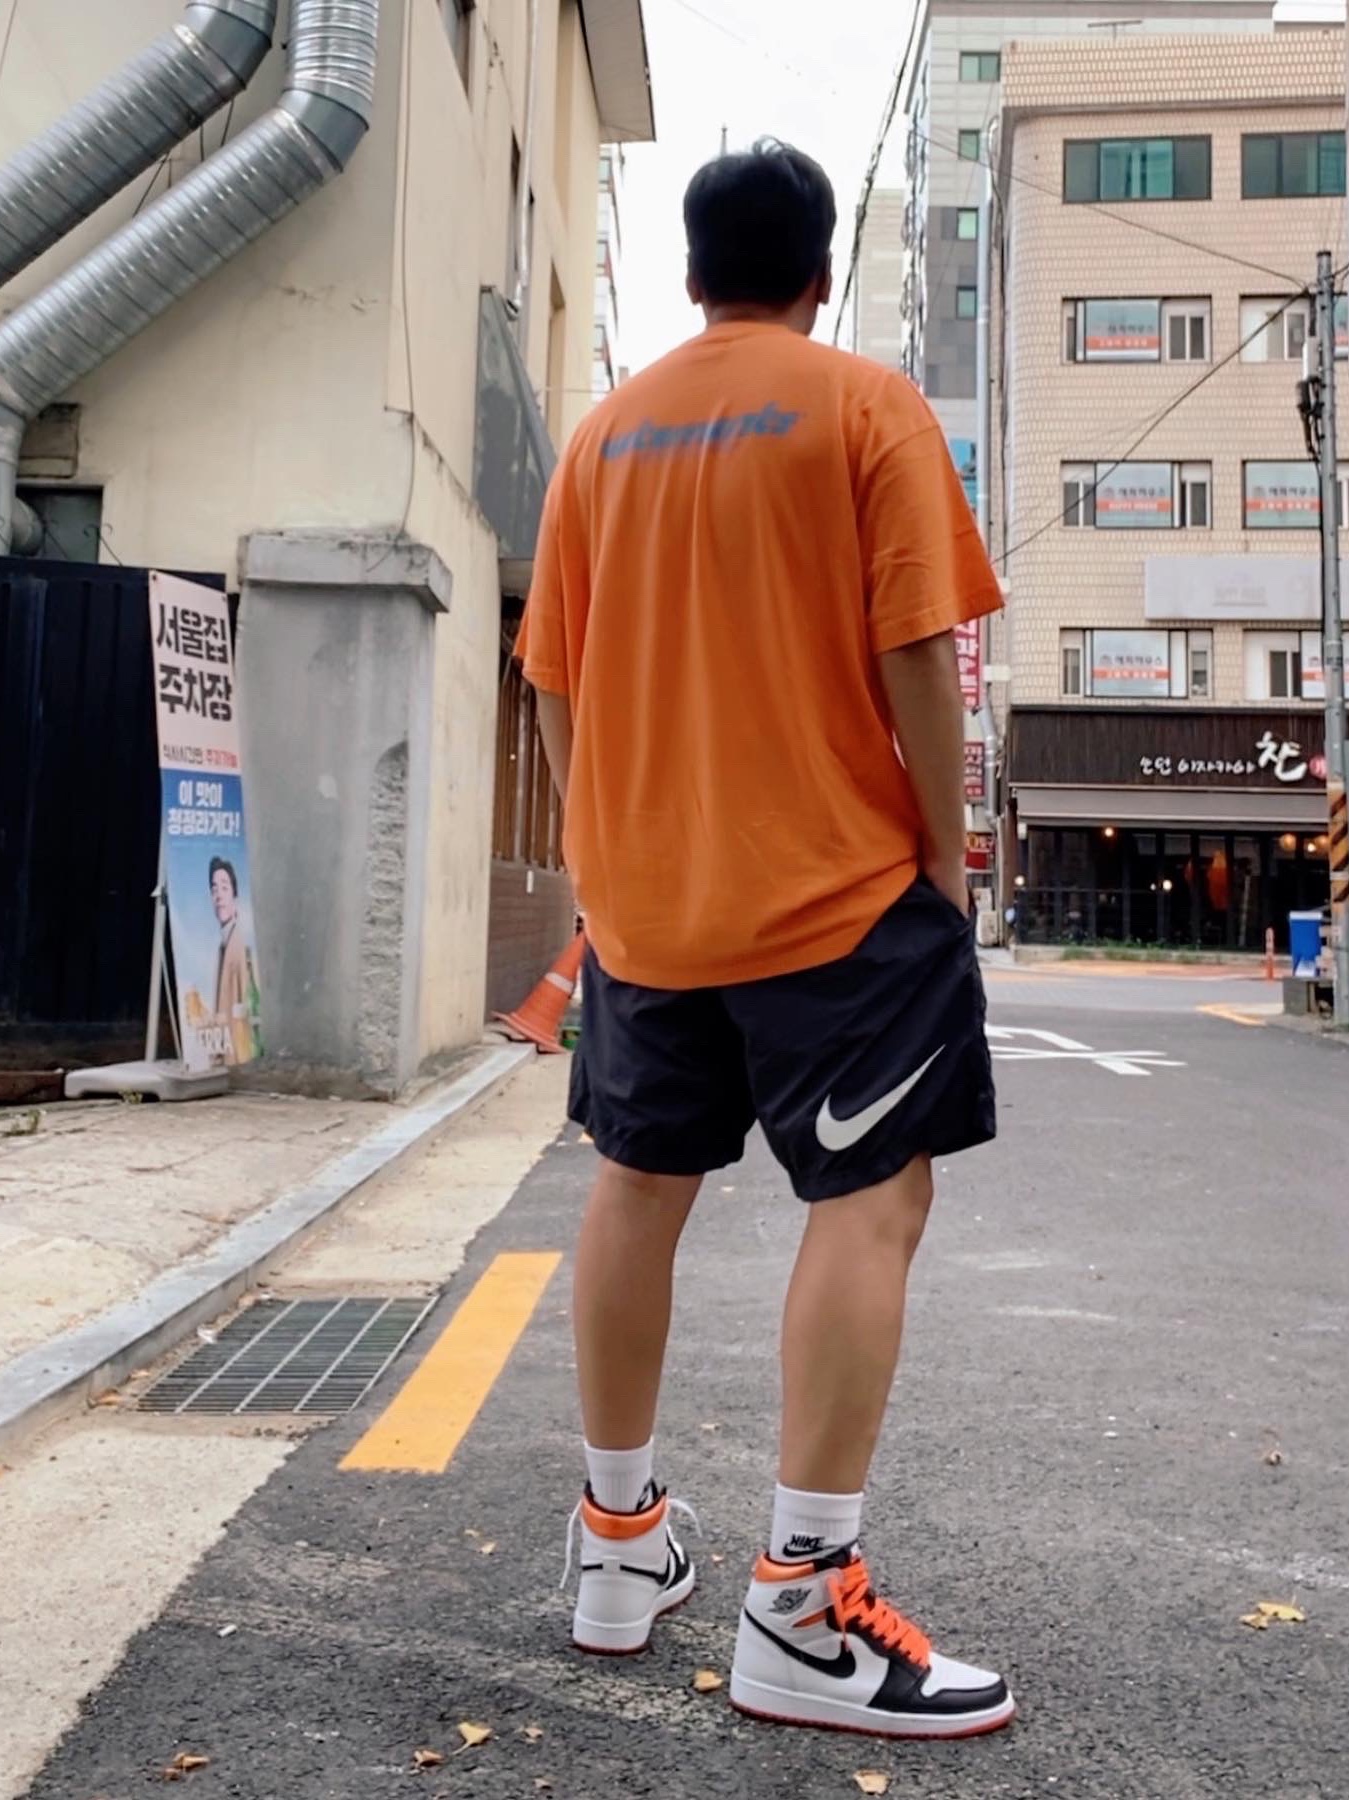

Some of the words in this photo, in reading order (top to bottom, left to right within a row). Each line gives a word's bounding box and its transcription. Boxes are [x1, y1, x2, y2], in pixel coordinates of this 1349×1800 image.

[157, 603, 229, 664] 서울집
[160, 662, 232, 722] 주차장
[178, 779, 193, 807] 이
[789, 1533, 826, 1549] NIKE
